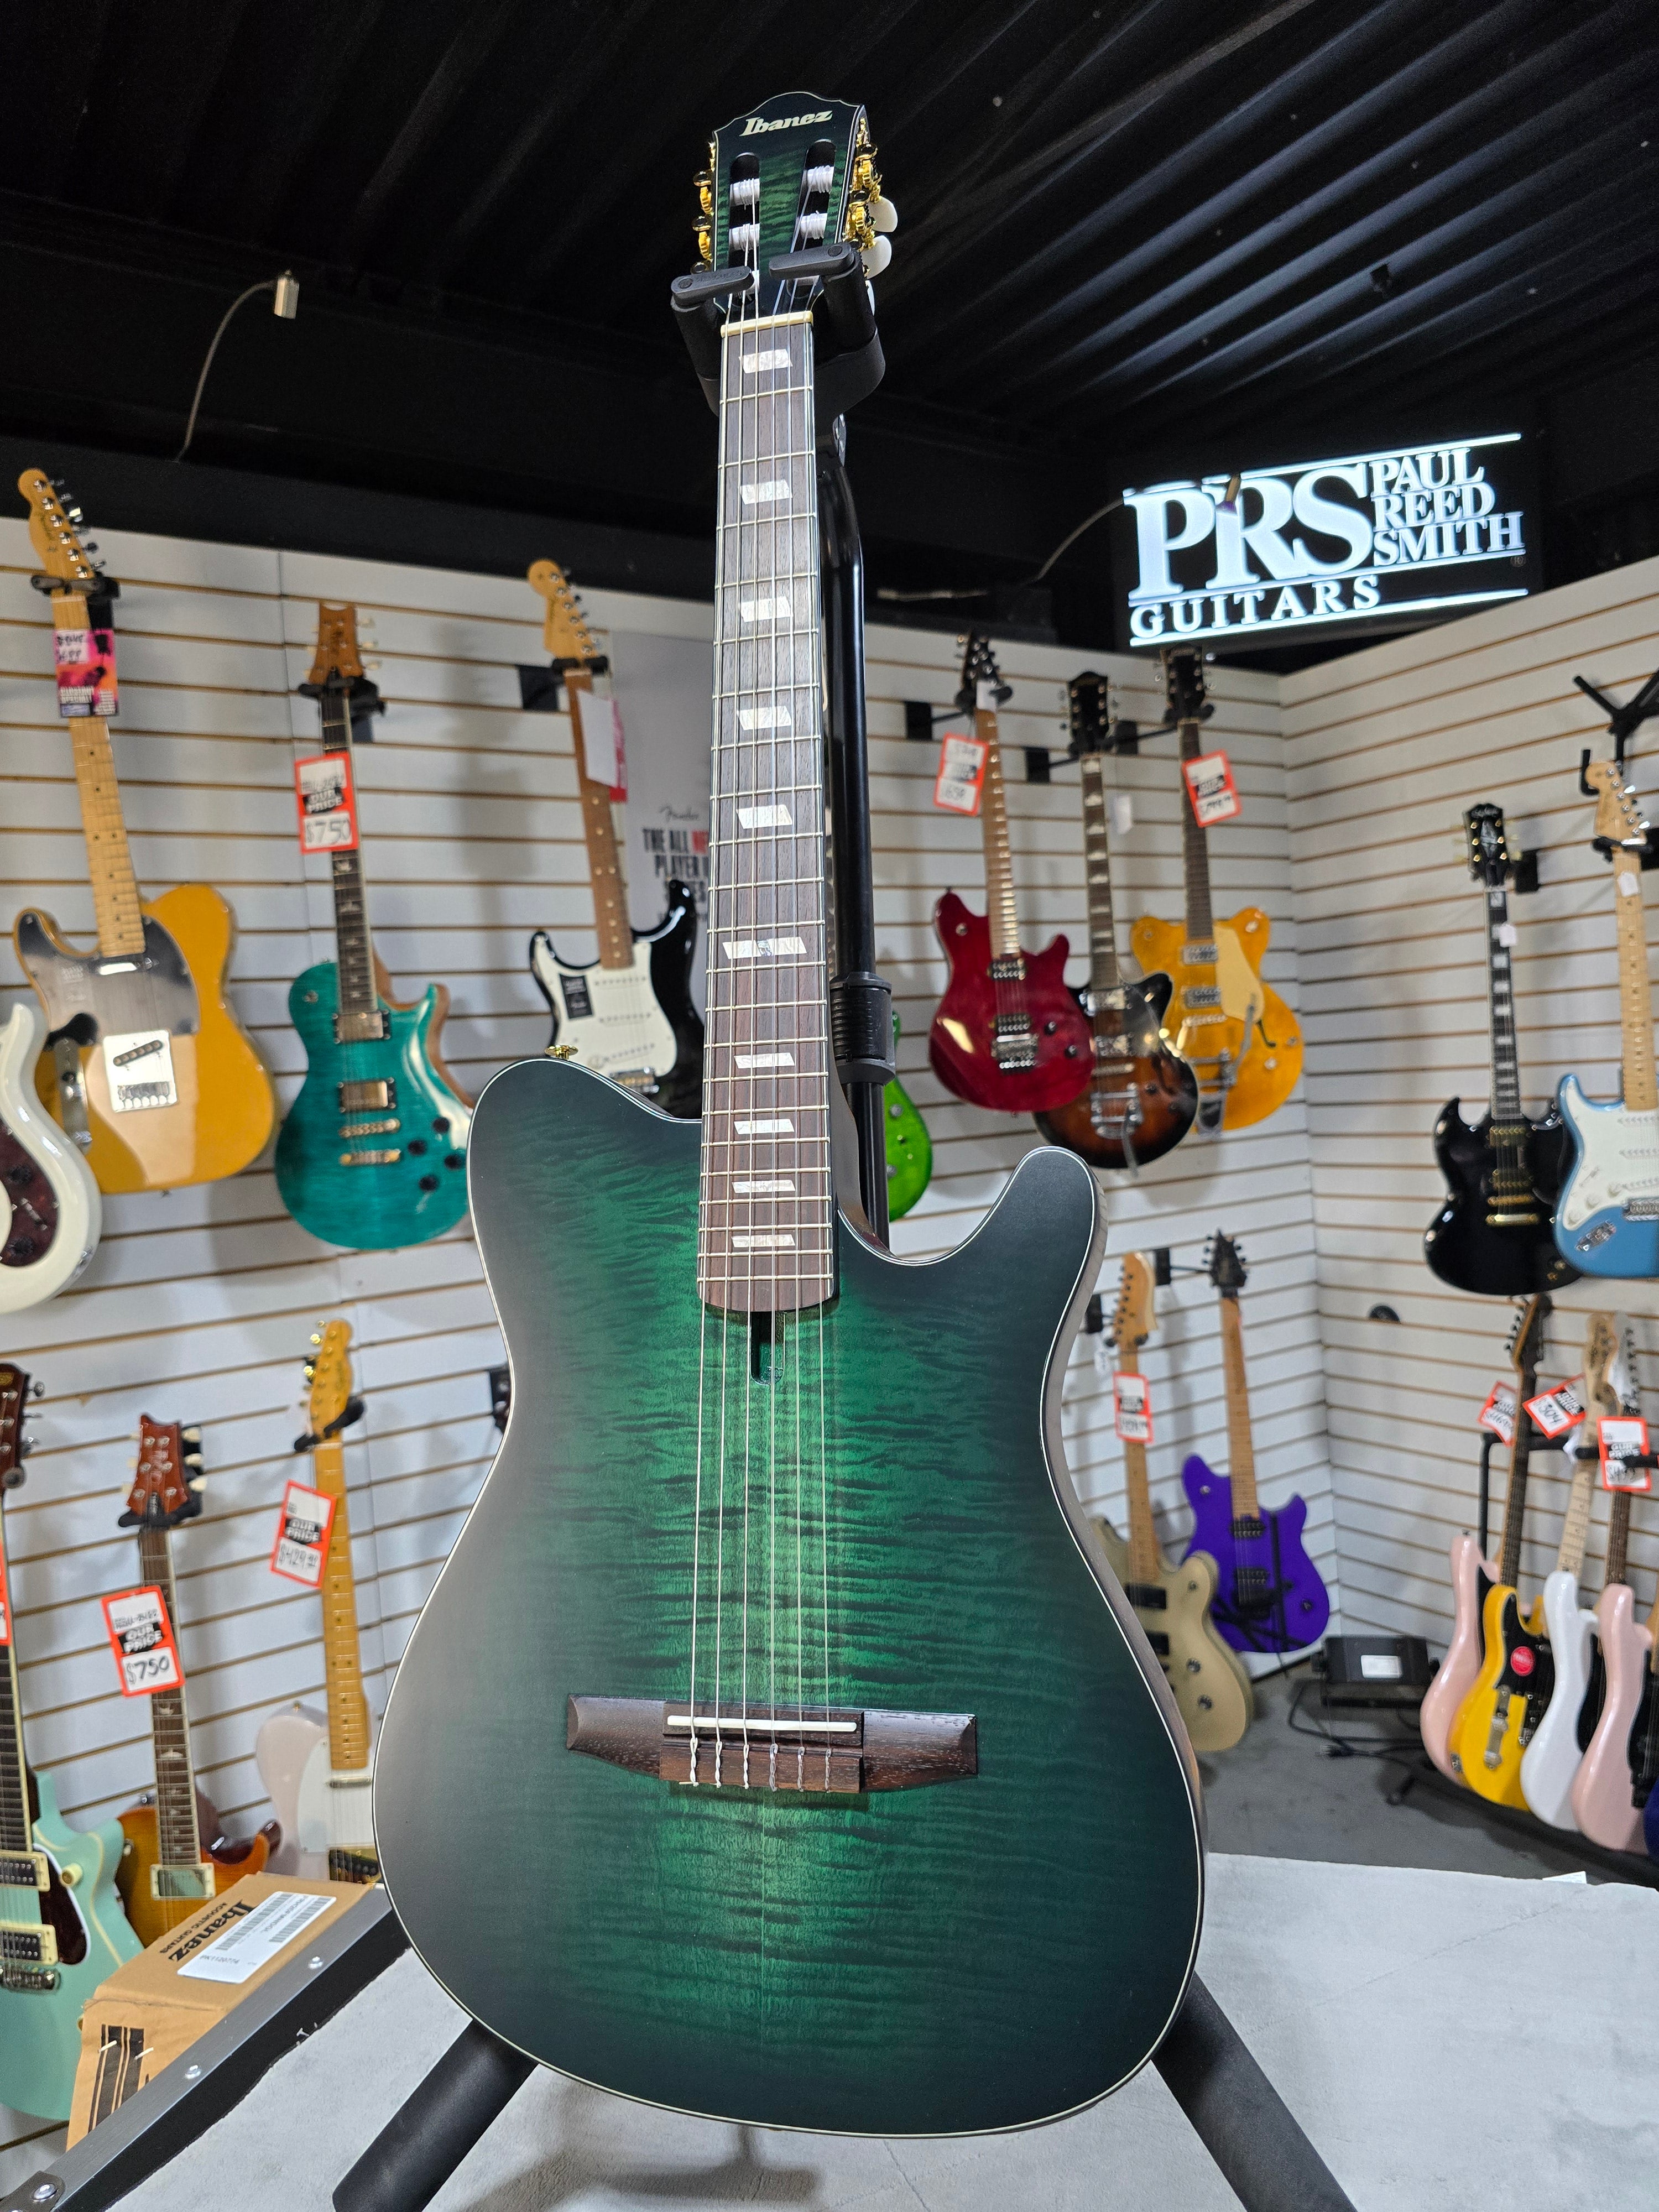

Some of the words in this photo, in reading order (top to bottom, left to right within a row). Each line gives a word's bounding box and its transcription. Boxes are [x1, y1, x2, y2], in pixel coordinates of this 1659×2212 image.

[739, 111, 833, 137] Ibanez
[1369, 447, 1484, 497] PAUL
[1371, 482, 1495, 532] REED
[1123, 462, 1373, 599] PRS
[1373, 510, 1526, 567] SMITH
[1130, 574, 1381, 639] GUITARS
[642, 828, 665, 853] THE
[285, 1526, 320, 1543] PRICE
[289, 1519, 315, 1532] OUR
[123, 1630, 163, 1653] PRICE
[125, 1623, 154, 1642] OUR
[126, 1655, 170, 1685] $750
[169, 1899, 257, 1962] Ibanez
